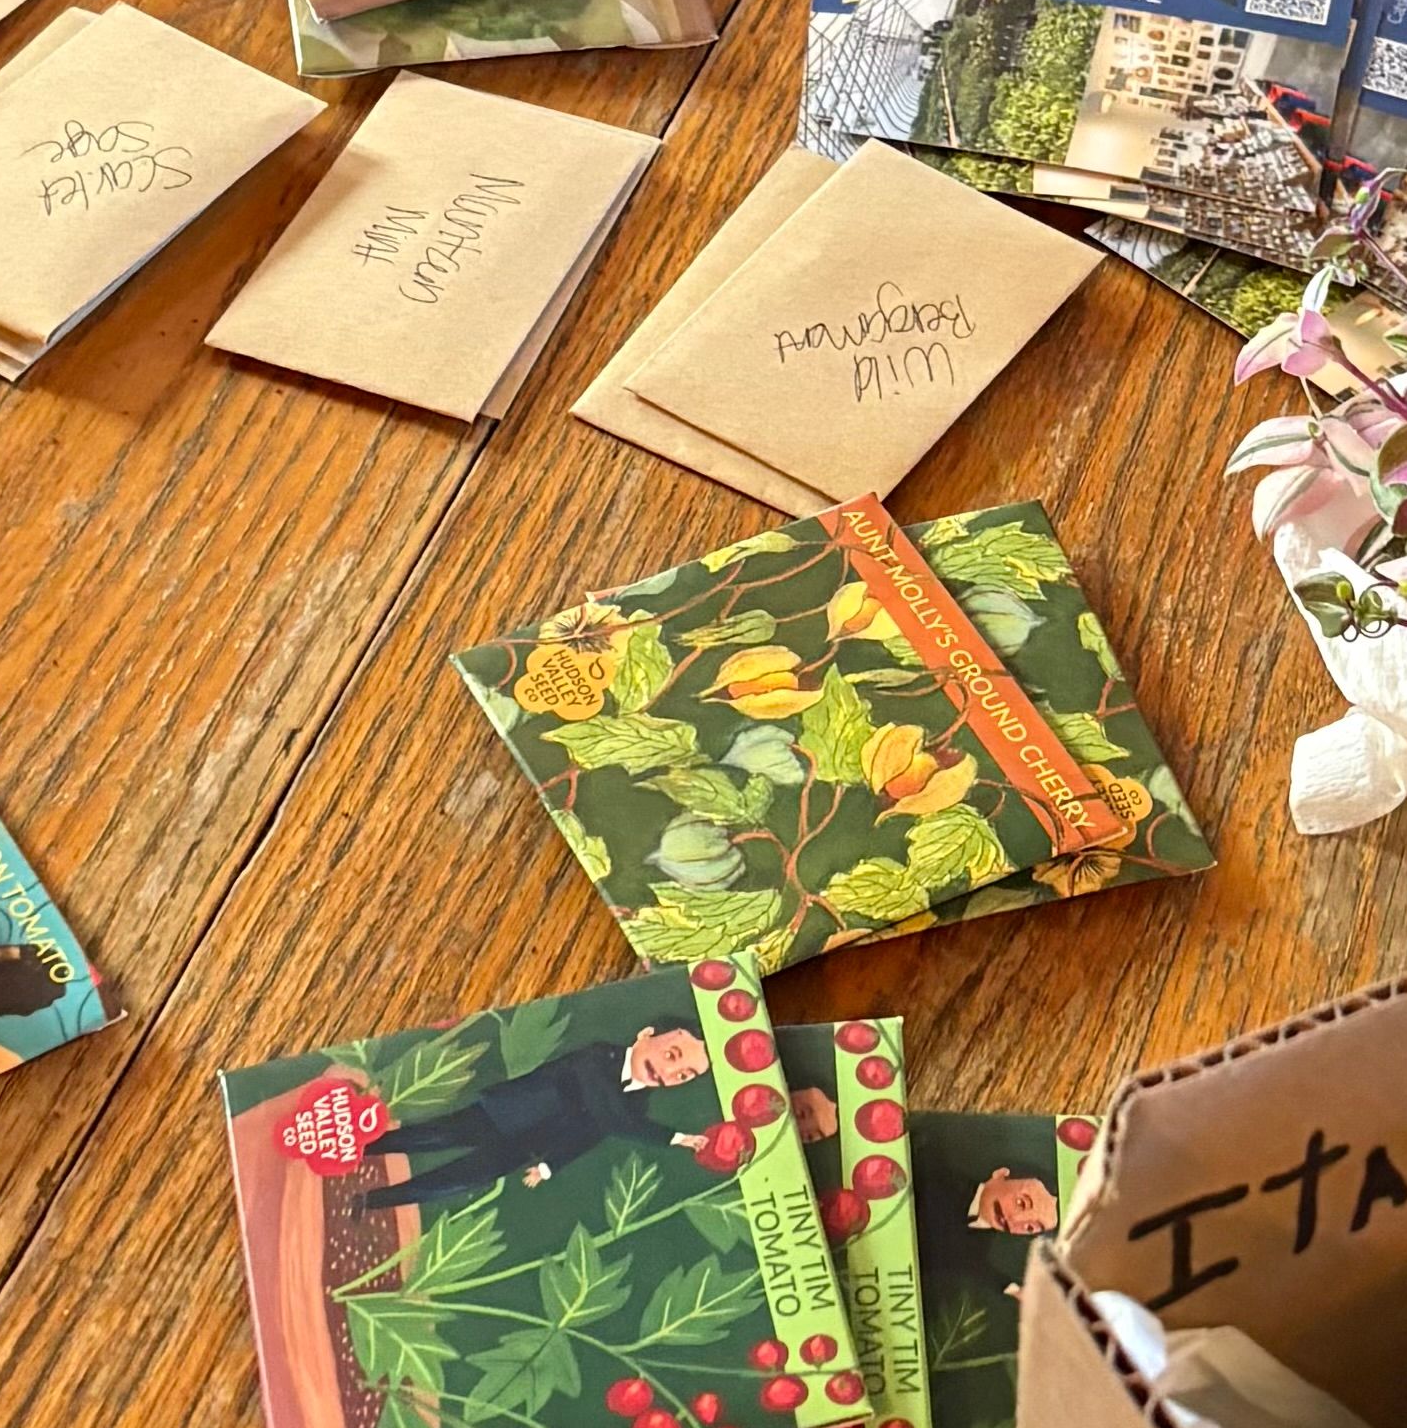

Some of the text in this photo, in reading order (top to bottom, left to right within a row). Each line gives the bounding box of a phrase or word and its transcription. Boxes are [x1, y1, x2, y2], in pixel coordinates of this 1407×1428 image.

[853, 339, 955, 404] Wild
[523, 687, 539, 702] CO
[529, 672, 560, 706] SEED
[541, 657, 583, 707] VALLEY
[553, 648, 601, 707] HUDSON
[842, 509, 1096, 831] AUNT MOLLY'S GROUND CHERRY
[1107, 781, 1136, 820] SEED
[1128, 789, 1143, 806] CO
[0, 883, 75, 986] TOMATO
[282, 1126, 298, 1147] CO
[295, 1111, 318, 1156] SEED
[312, 1094, 339, 1161] VALLEY
[330, 1086, 358, 1163] HUDSON
[749, 1191, 802, 1318] TOMATO
[782, 1184, 837, 1312] TINY TIM
[853, 1266, 887, 1398] TOMATO
[886, 1263, 922, 1395] TINY TIM
